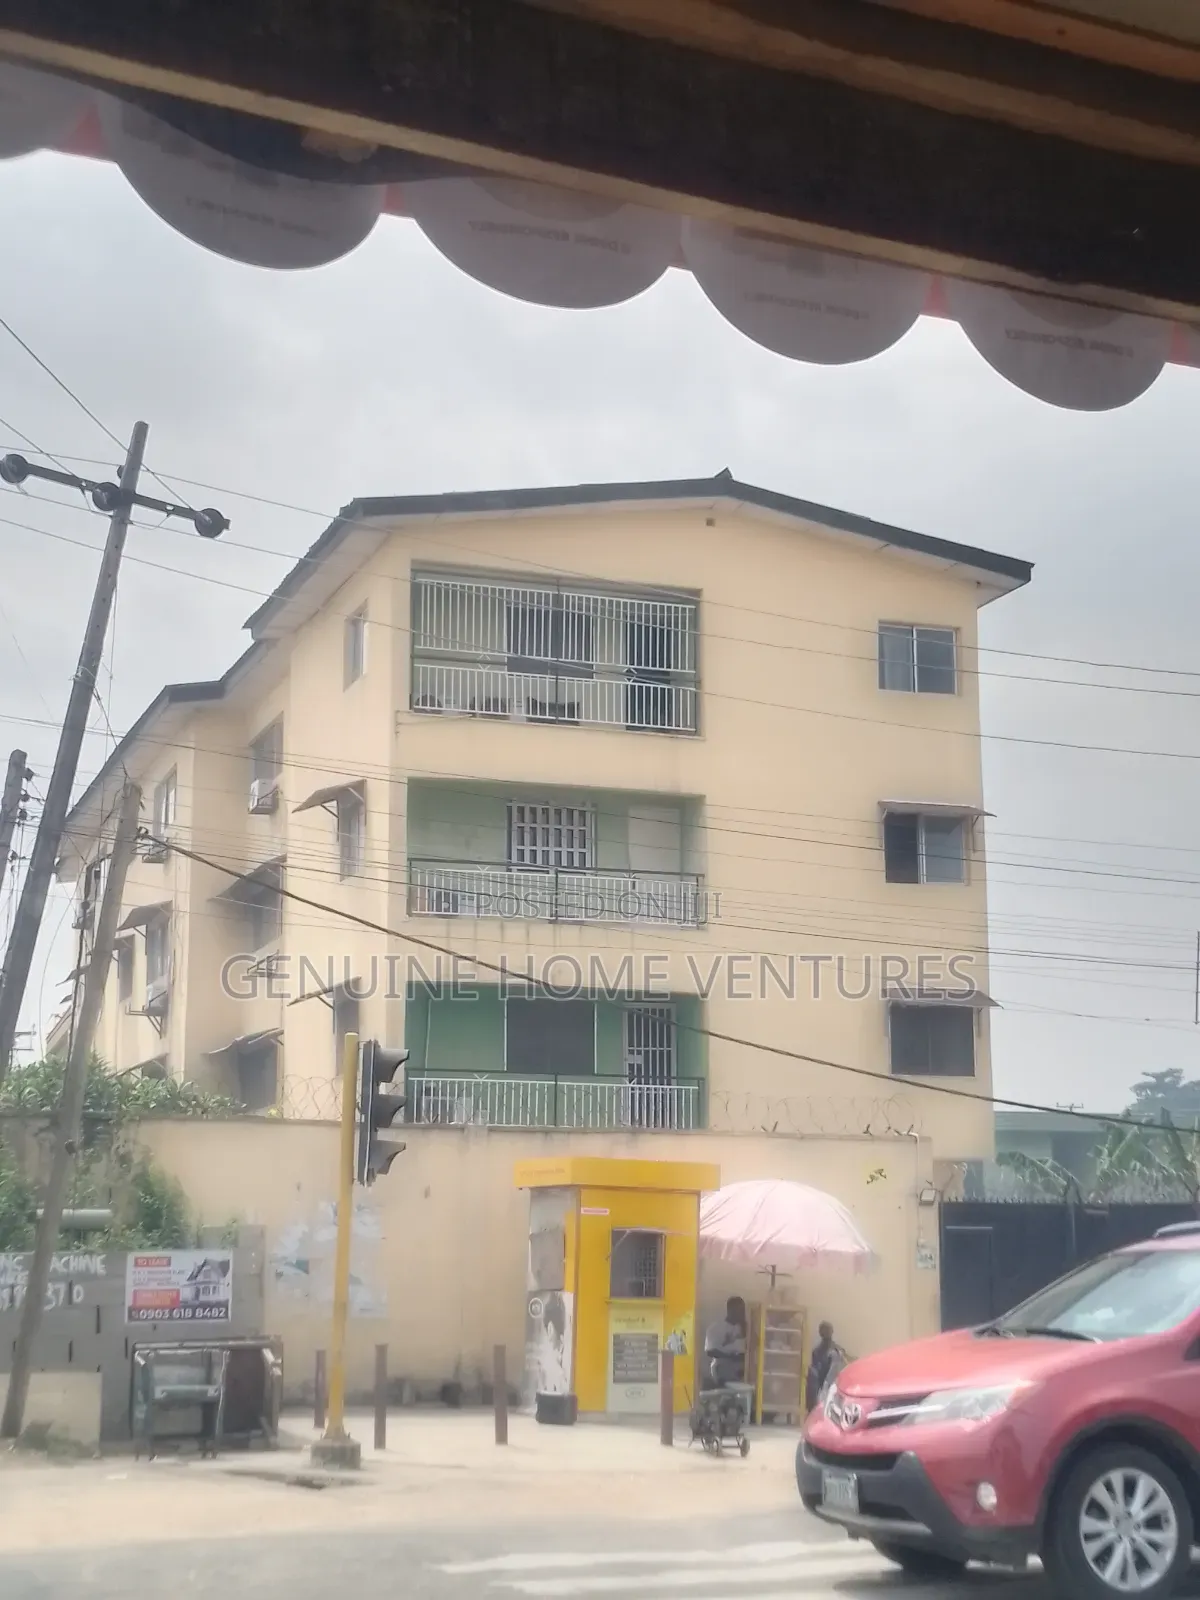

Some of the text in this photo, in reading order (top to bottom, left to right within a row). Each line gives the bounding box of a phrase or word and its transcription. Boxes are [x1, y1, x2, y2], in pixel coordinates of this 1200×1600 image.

[49, 1253, 107, 1276] ACHINE
[140, 1308, 170, 1320] 0903
[195, 1307, 226, 1319] 8482
